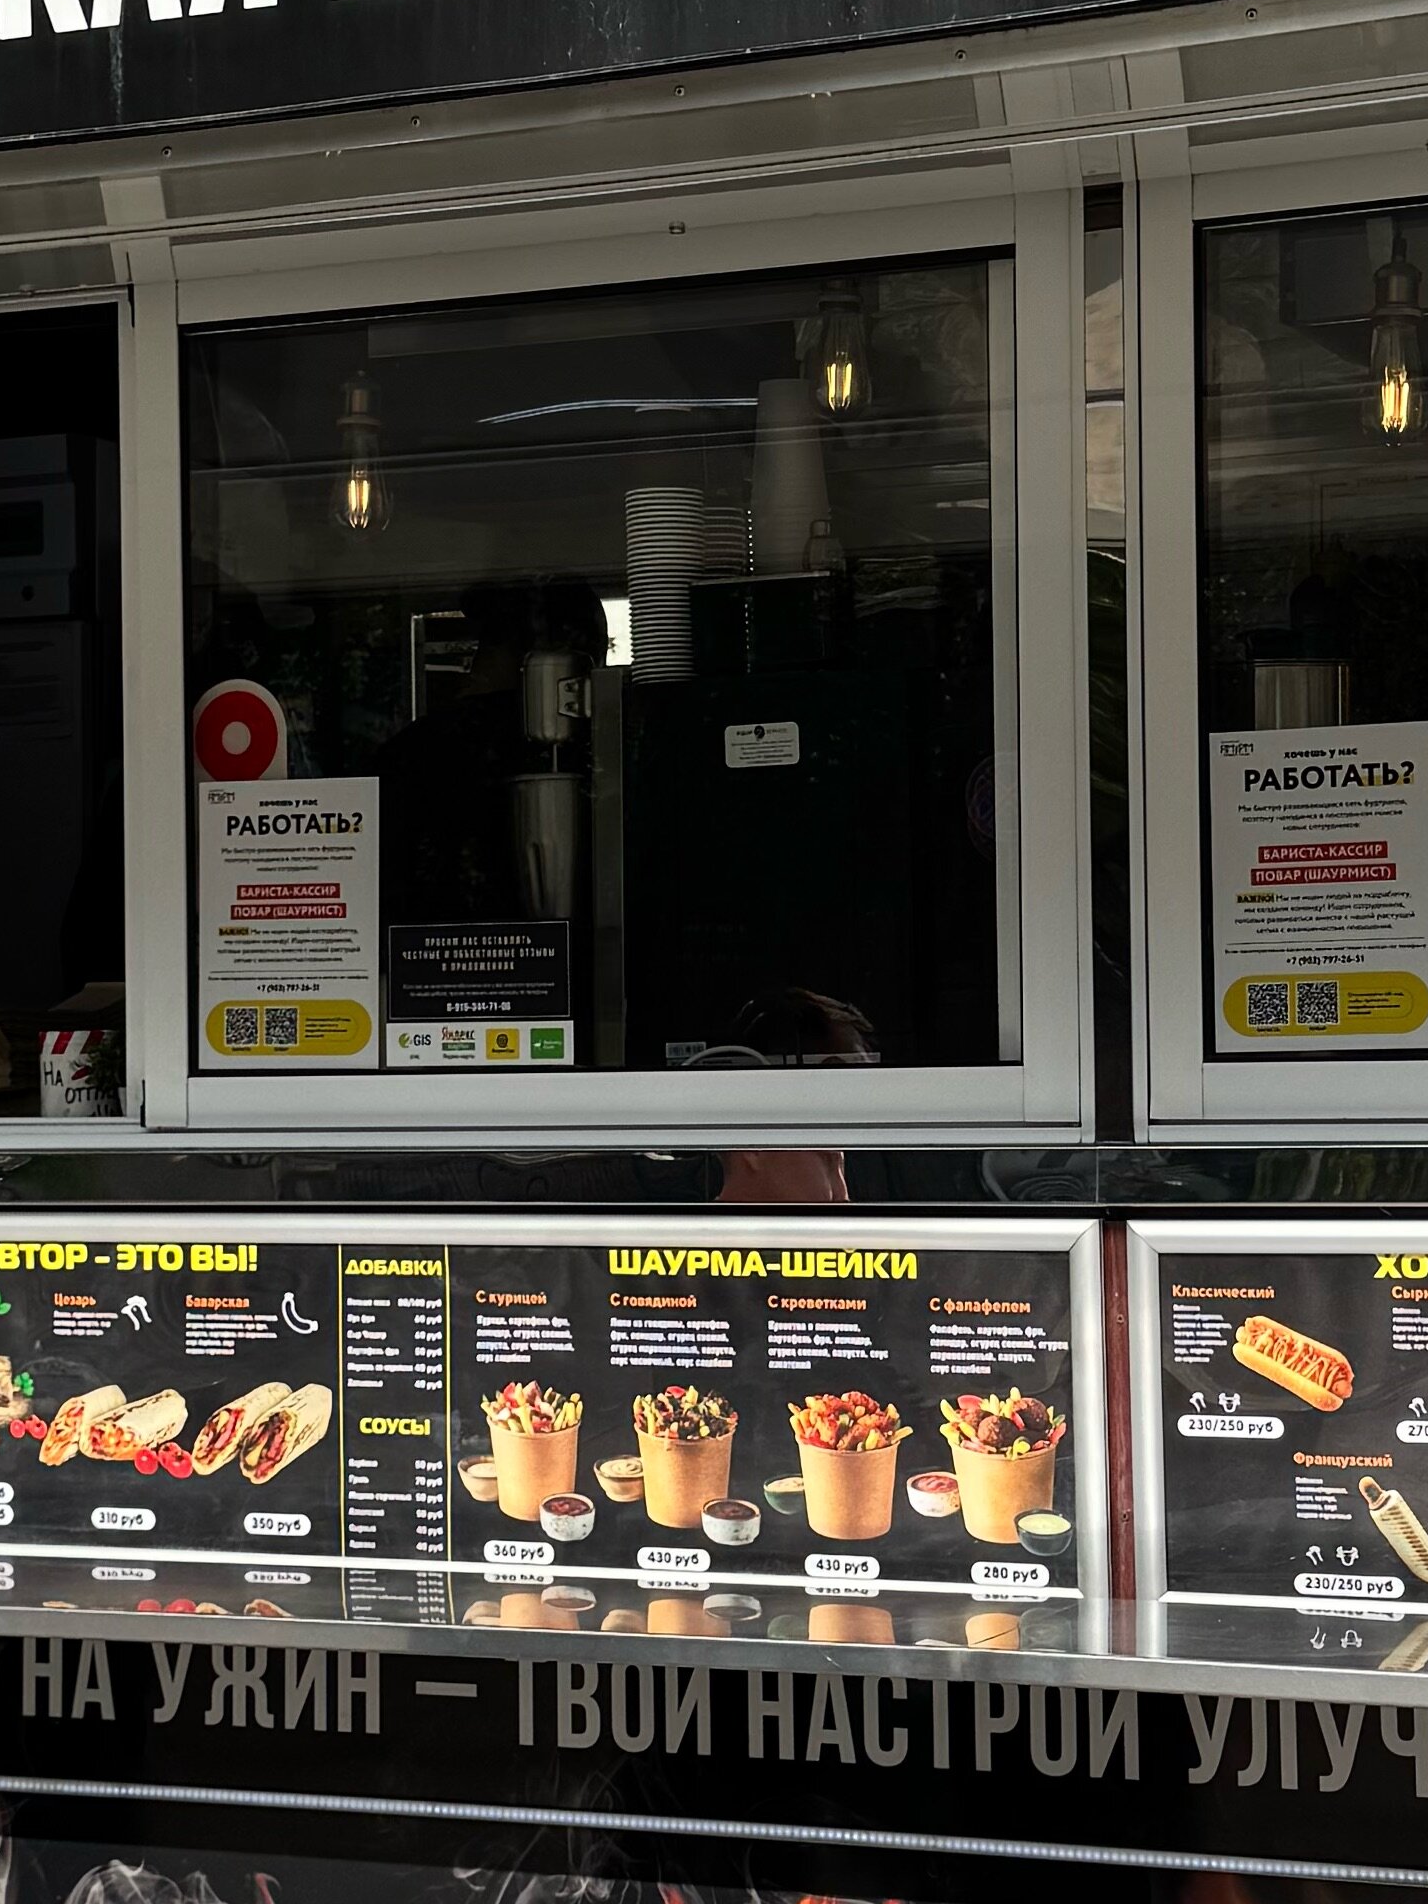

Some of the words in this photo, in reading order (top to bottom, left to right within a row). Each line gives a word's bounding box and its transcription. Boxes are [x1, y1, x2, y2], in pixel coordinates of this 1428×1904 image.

[1244, 760, 1414, 792] РАБОТАТЬ?
[227, 812, 363, 836] РАБОТАТЬ?
[1263, 844, 1383, 859] БАРИСТА-КАССИР
[1256, 869, 1301, 882] ПОВАР
[1304, 865, 1391, 882] (ШАУРМИСТ)
[240, 886, 336, 898] БАРИСТА-КАССИР
[233, 907, 271, 918] ПОВАР
[117, 1244, 184, 1271] ЭТО
[190, 1244, 259, 1271] ВЫ!
[609, 1247, 918, 1280] ШАУРМА-ШЕЙКИ
[345, 1260, 443, 1275] ДОБАВКИ
[476, 1289, 486, 1303] С
[489, 1291, 547, 1307] курицей
[1172, 1284, 1275, 1299] Классический
[54, 1293, 96, 1309] Цезарь
[186, 1294, 249, 1309] Баварская
[610, 1292, 620, 1306] С
[623, 1294, 697, 1308] говядиной
[768, 1295, 779, 1308] С
[781, 1297, 867, 1312] креветками
[929, 1297, 941, 1311] С
[943, 1299, 1031, 1315] фалафелем
[360, 1417, 431, 1435] СОУСЫ
[1188, 1419, 1244, 1432] 230/250
[1248, 1420, 1273, 1435] руб
[1293, 1453, 1393, 1469] Французский
[98, 1511, 118, 1525] 310
[121, 1512, 144, 1528] руб
[252, 1517, 274, 1529] 350
[277, 1517, 301, 1533] руб
[494, 1544, 517, 1557] 360
[521, 1546, 545, 1561] руб
[647, 1552, 671, 1565] 430
[675, 1553, 700, 1568] руб
[816, 1559, 839, 1572] 430
[843, 1560, 868, 1574] руб
[984, 1567, 1008, 1580] 280
[1012, 1568, 1038, 1583] руб
[1305, 1577, 1362, 1591] 230/250
[1367, 1578, 1393, 1593] руб
[21, 1632, 116, 1720] НА
[149, 1640, 382, 1734] УЖИН
